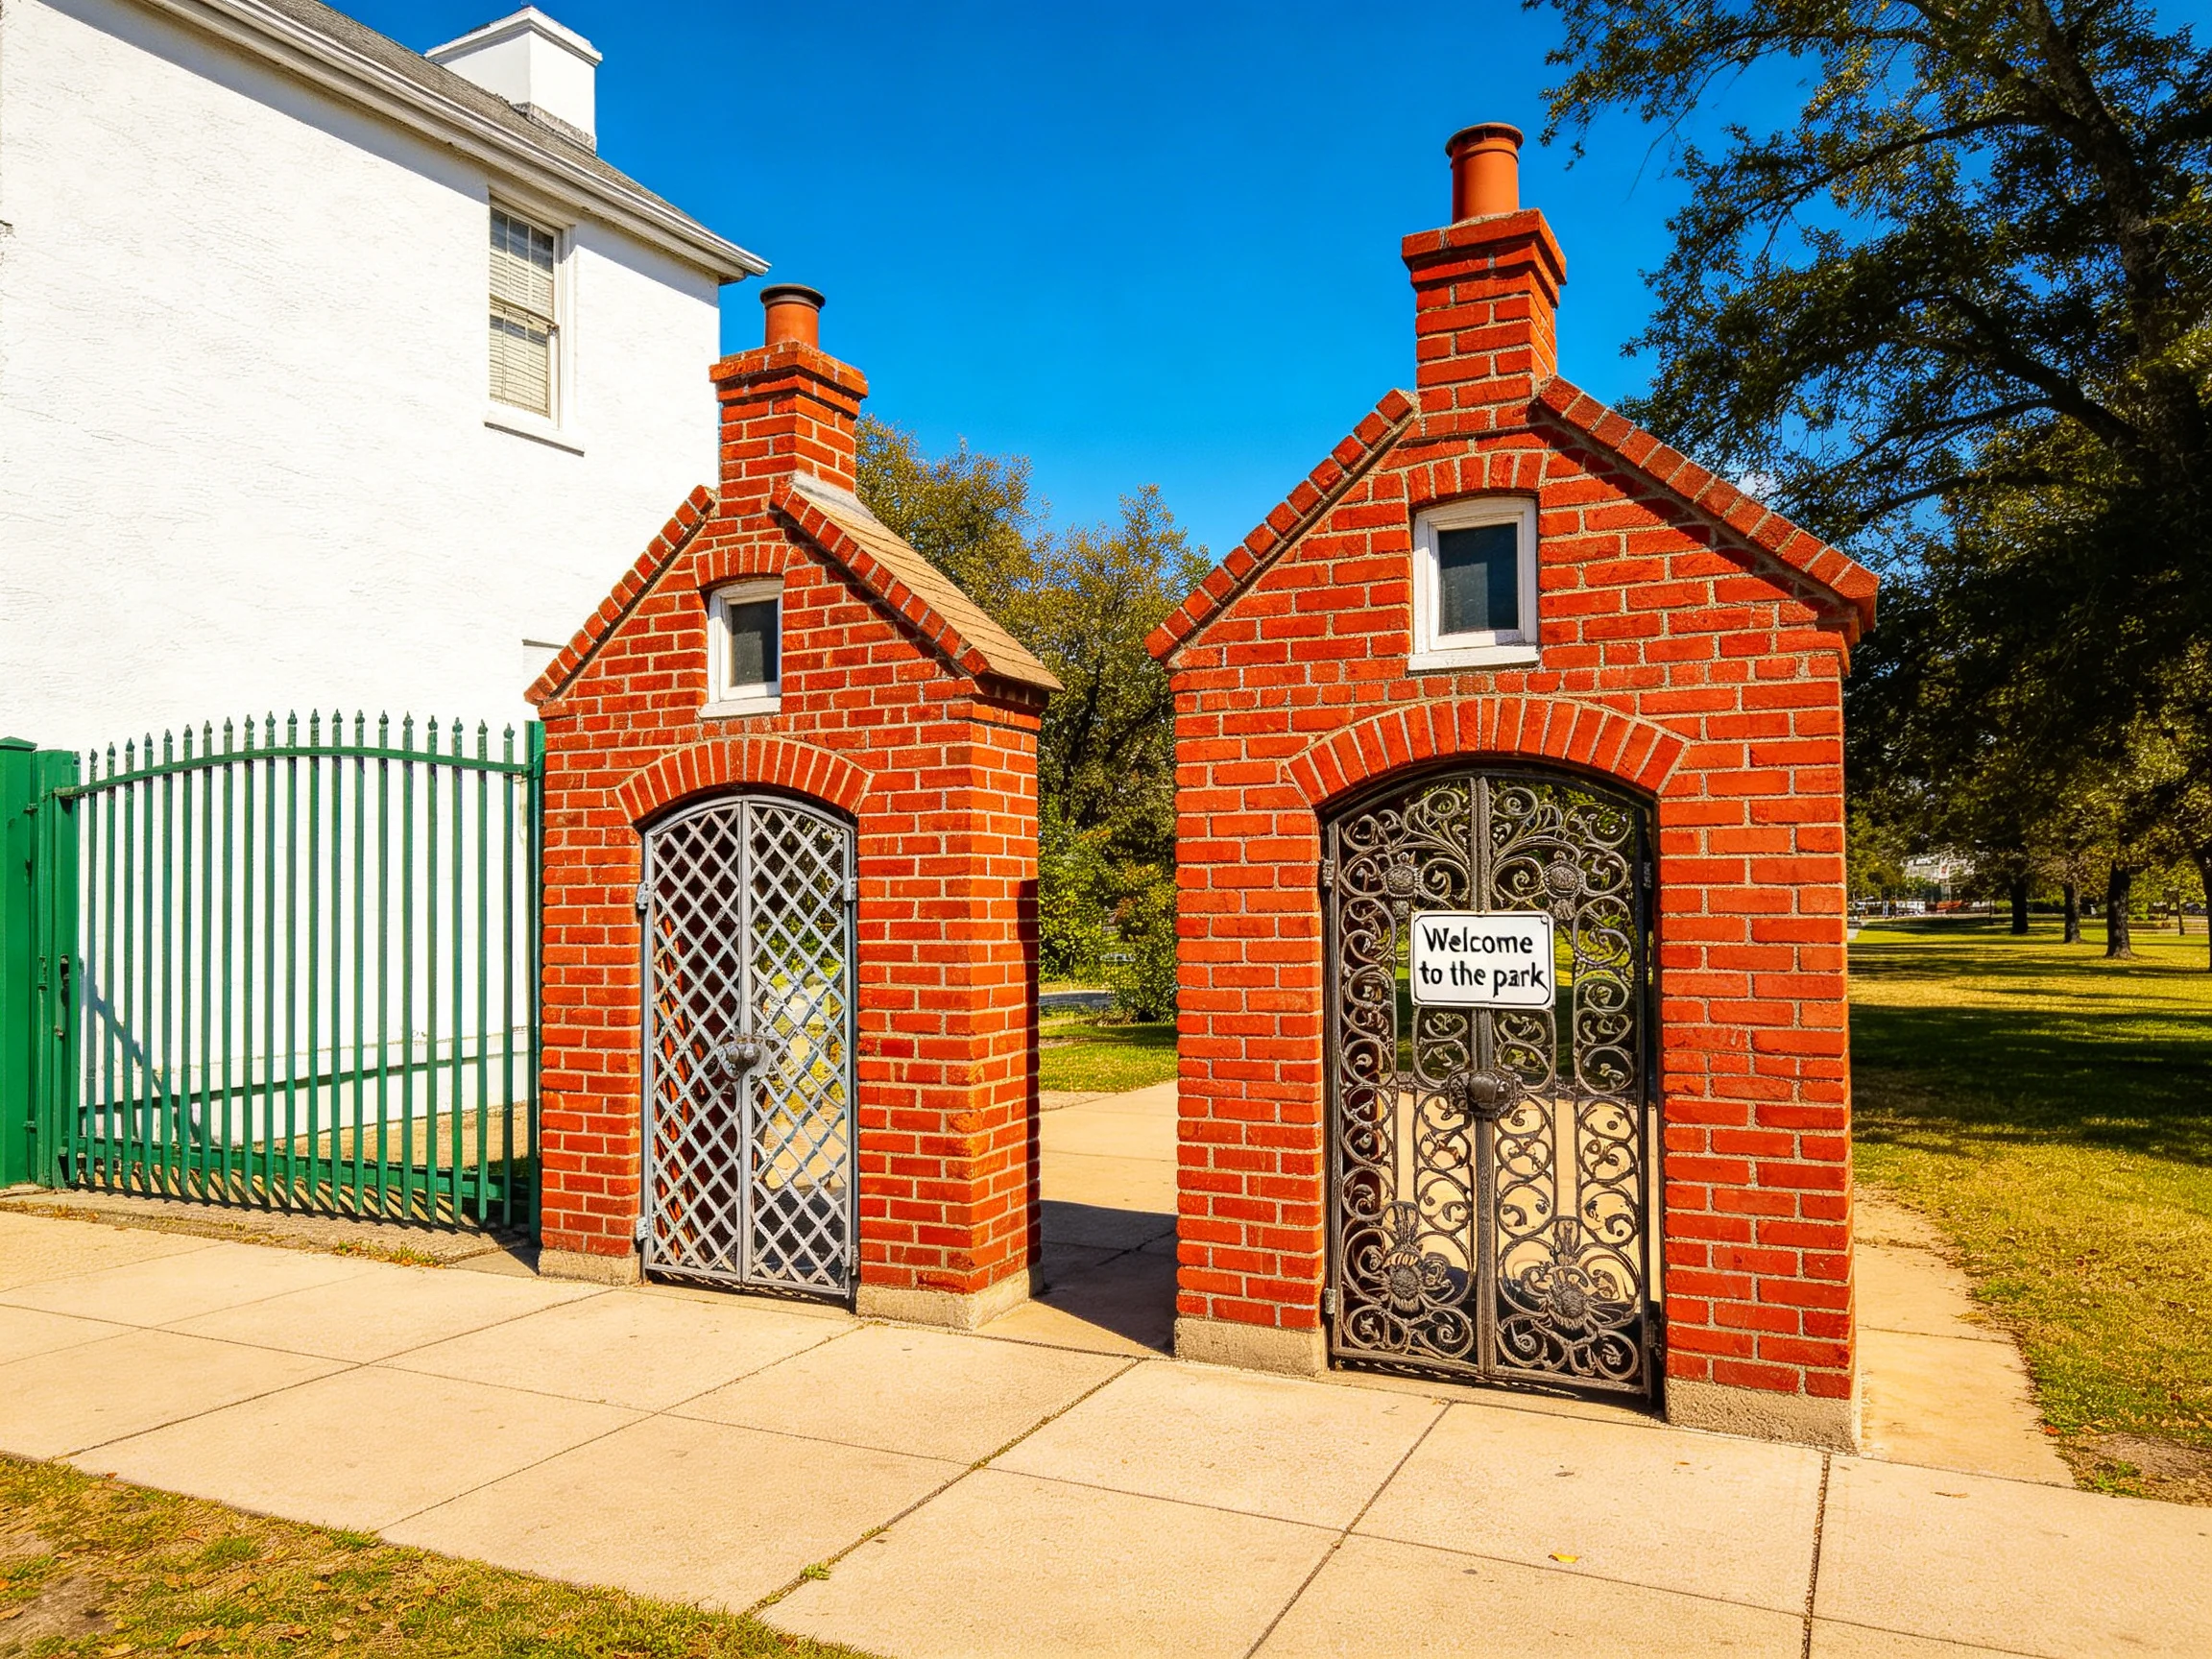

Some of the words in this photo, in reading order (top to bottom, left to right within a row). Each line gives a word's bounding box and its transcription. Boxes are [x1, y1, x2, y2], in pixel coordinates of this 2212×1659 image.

[1421, 923, 1533, 953] Welcome
[1419, 960, 1443, 985] to
[1450, 960, 1486, 986] the
[1493, 962, 1550, 998] park
